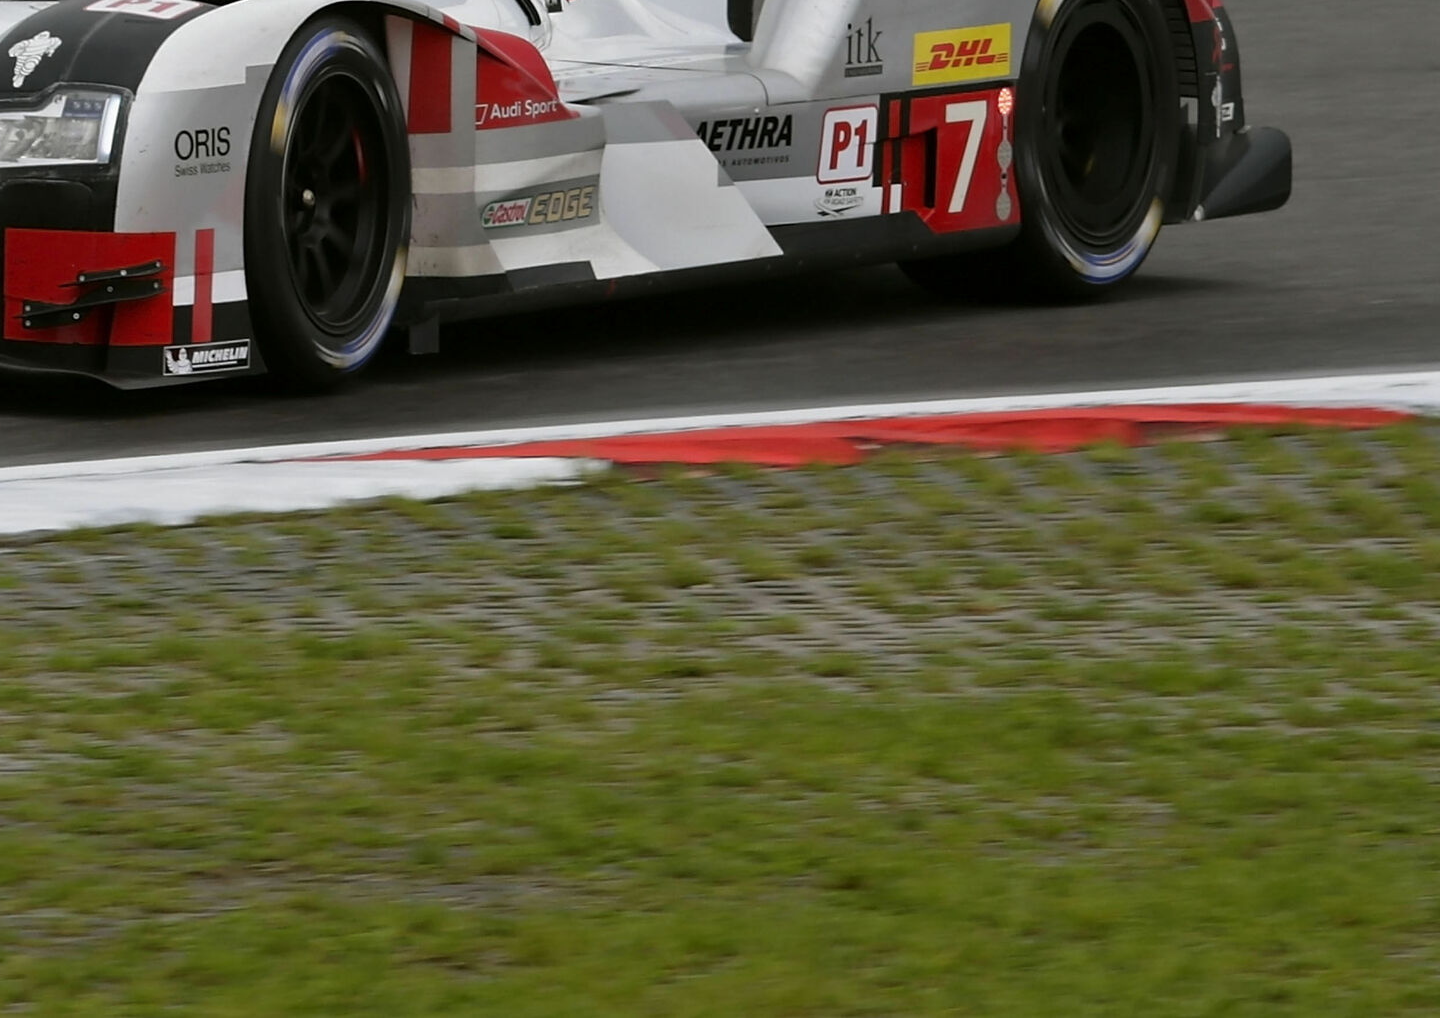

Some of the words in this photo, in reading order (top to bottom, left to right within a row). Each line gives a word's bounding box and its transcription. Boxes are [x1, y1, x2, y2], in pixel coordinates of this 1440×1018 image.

[845, 15, 883, 66] itk
[928, 38, 997, 71] DHL
[490, 101, 522, 120] Audi
[524, 98, 558, 119] Sport
[174, 126, 231, 161] ORIS
[696, 113, 793, 153] AETHRA
[829, 118, 869, 171] P1
[945, 99, 988, 214] 7
[491, 200, 529, 225] Castrol
[528, 184, 596, 225] EDGE
[191, 346, 249, 364] MICHELIN
